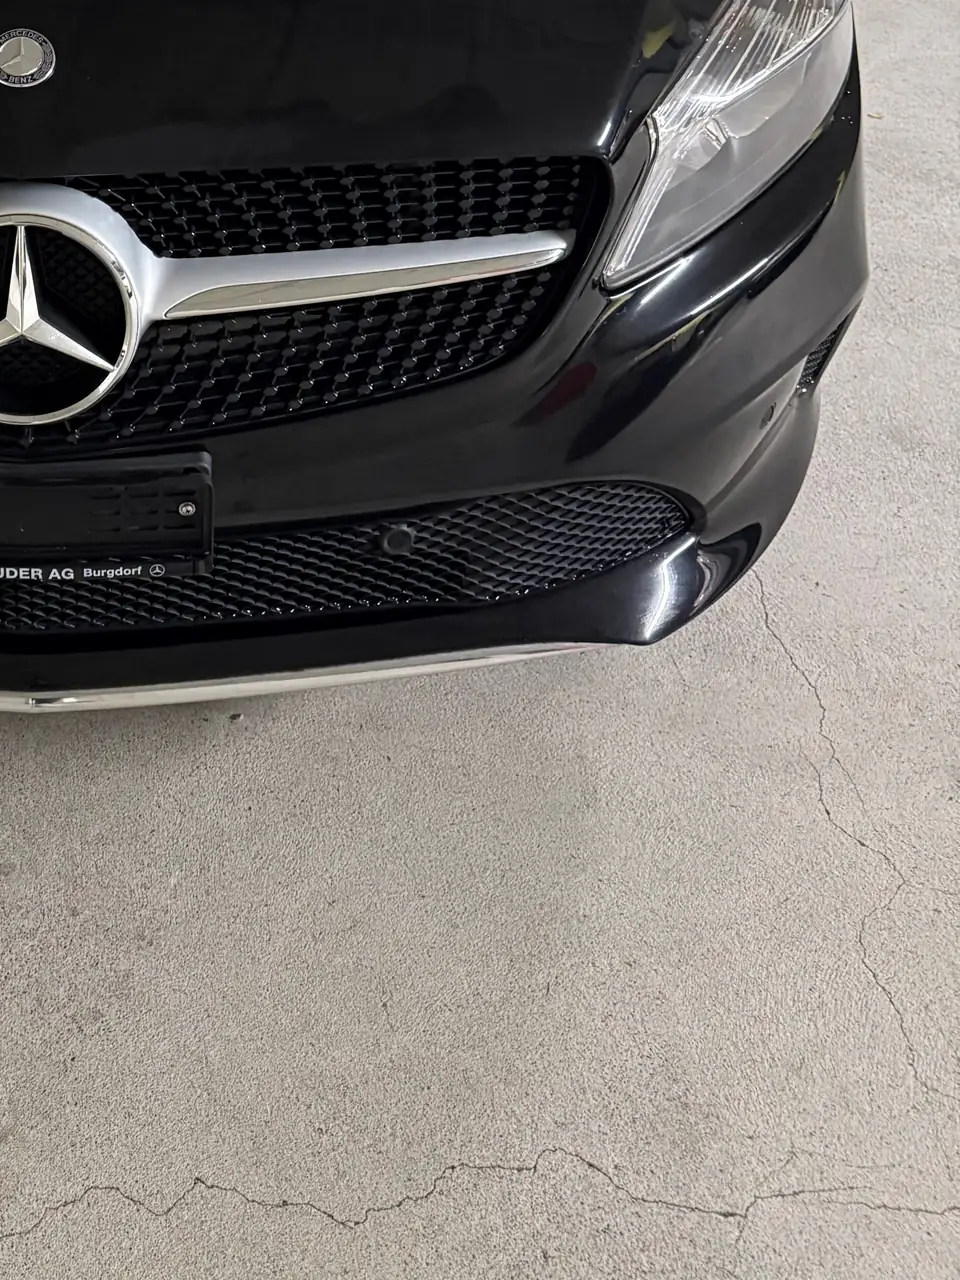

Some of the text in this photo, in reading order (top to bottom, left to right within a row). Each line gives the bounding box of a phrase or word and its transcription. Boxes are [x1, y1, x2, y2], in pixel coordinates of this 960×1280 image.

[7, 75, 34, 84] BENZ
[48, 568, 75, 580] AG
[83, 566, 142, 578] Burgdorf
